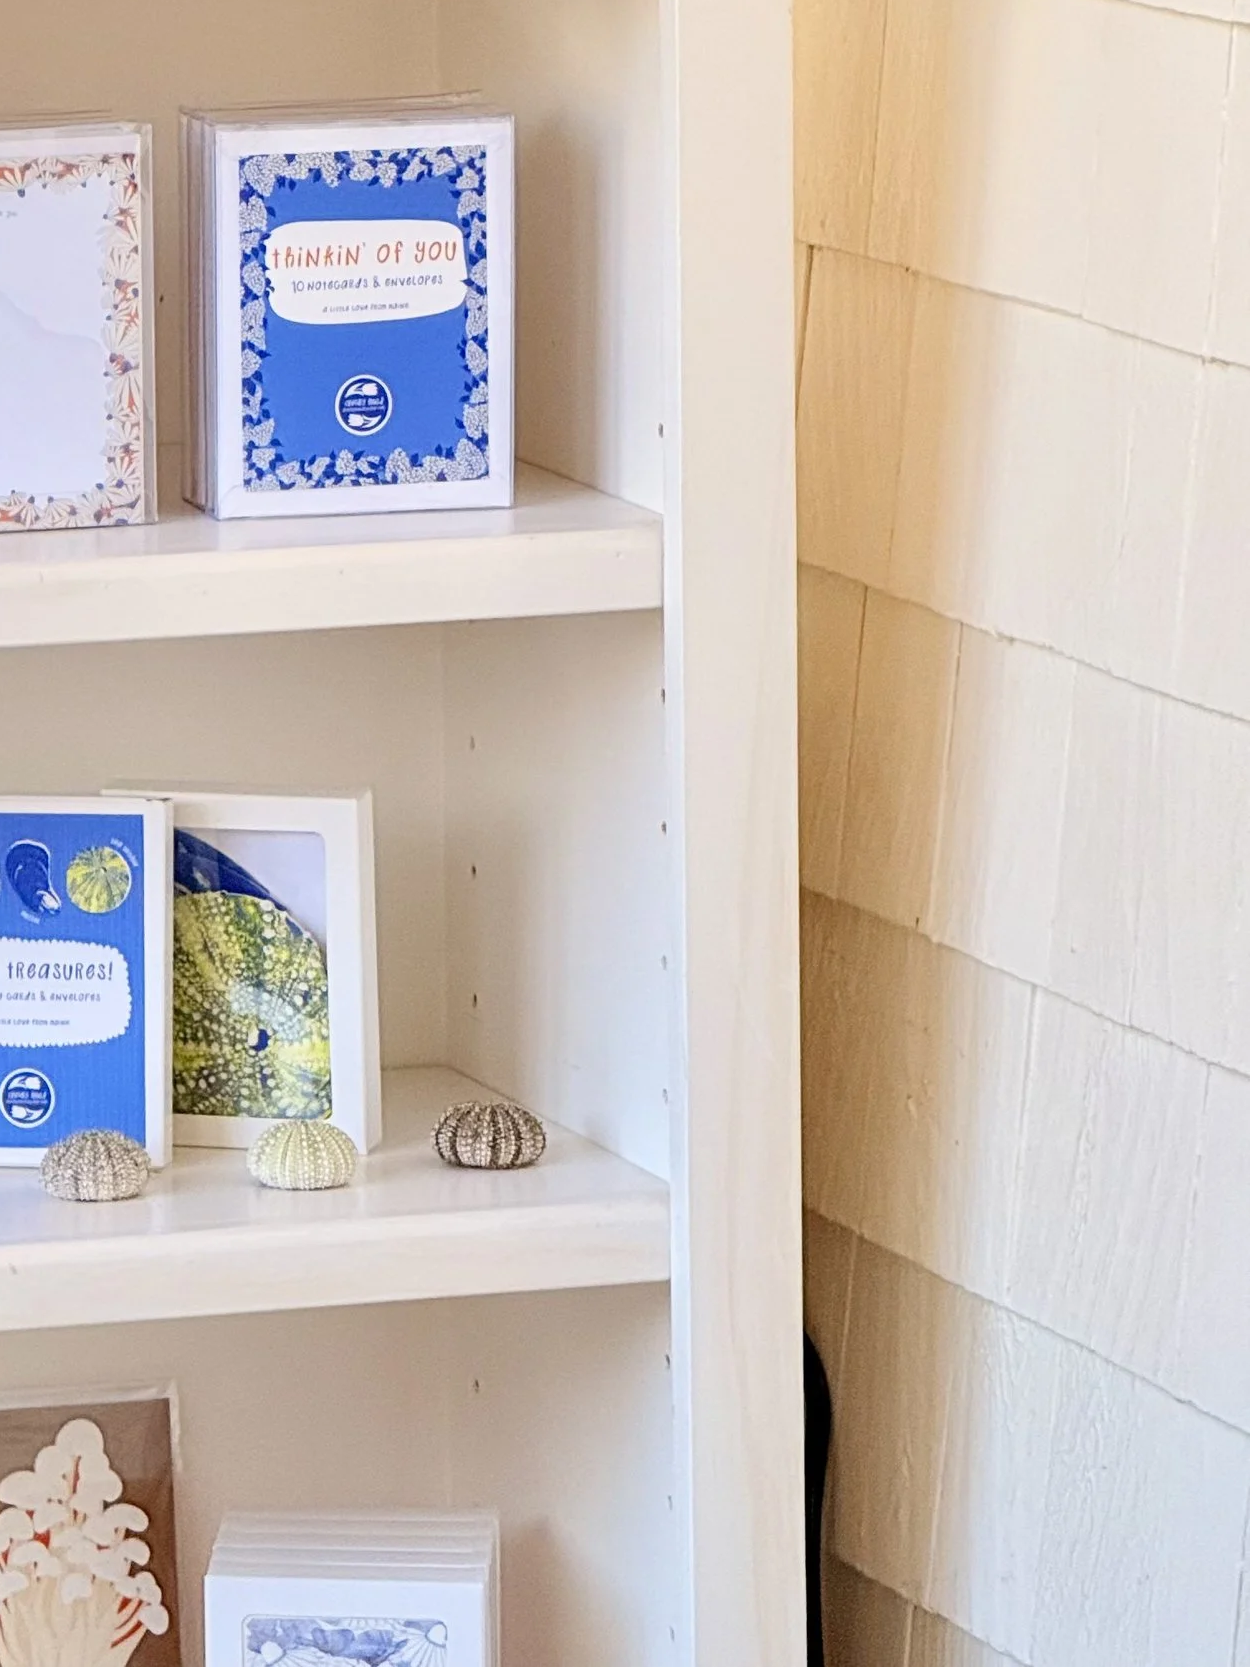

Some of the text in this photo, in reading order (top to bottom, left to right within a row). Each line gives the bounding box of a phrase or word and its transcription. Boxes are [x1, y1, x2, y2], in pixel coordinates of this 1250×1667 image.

[291, 281, 304, 294] 10
[373, 276, 381, 288] &
[40, 990, 47, 1001] &
